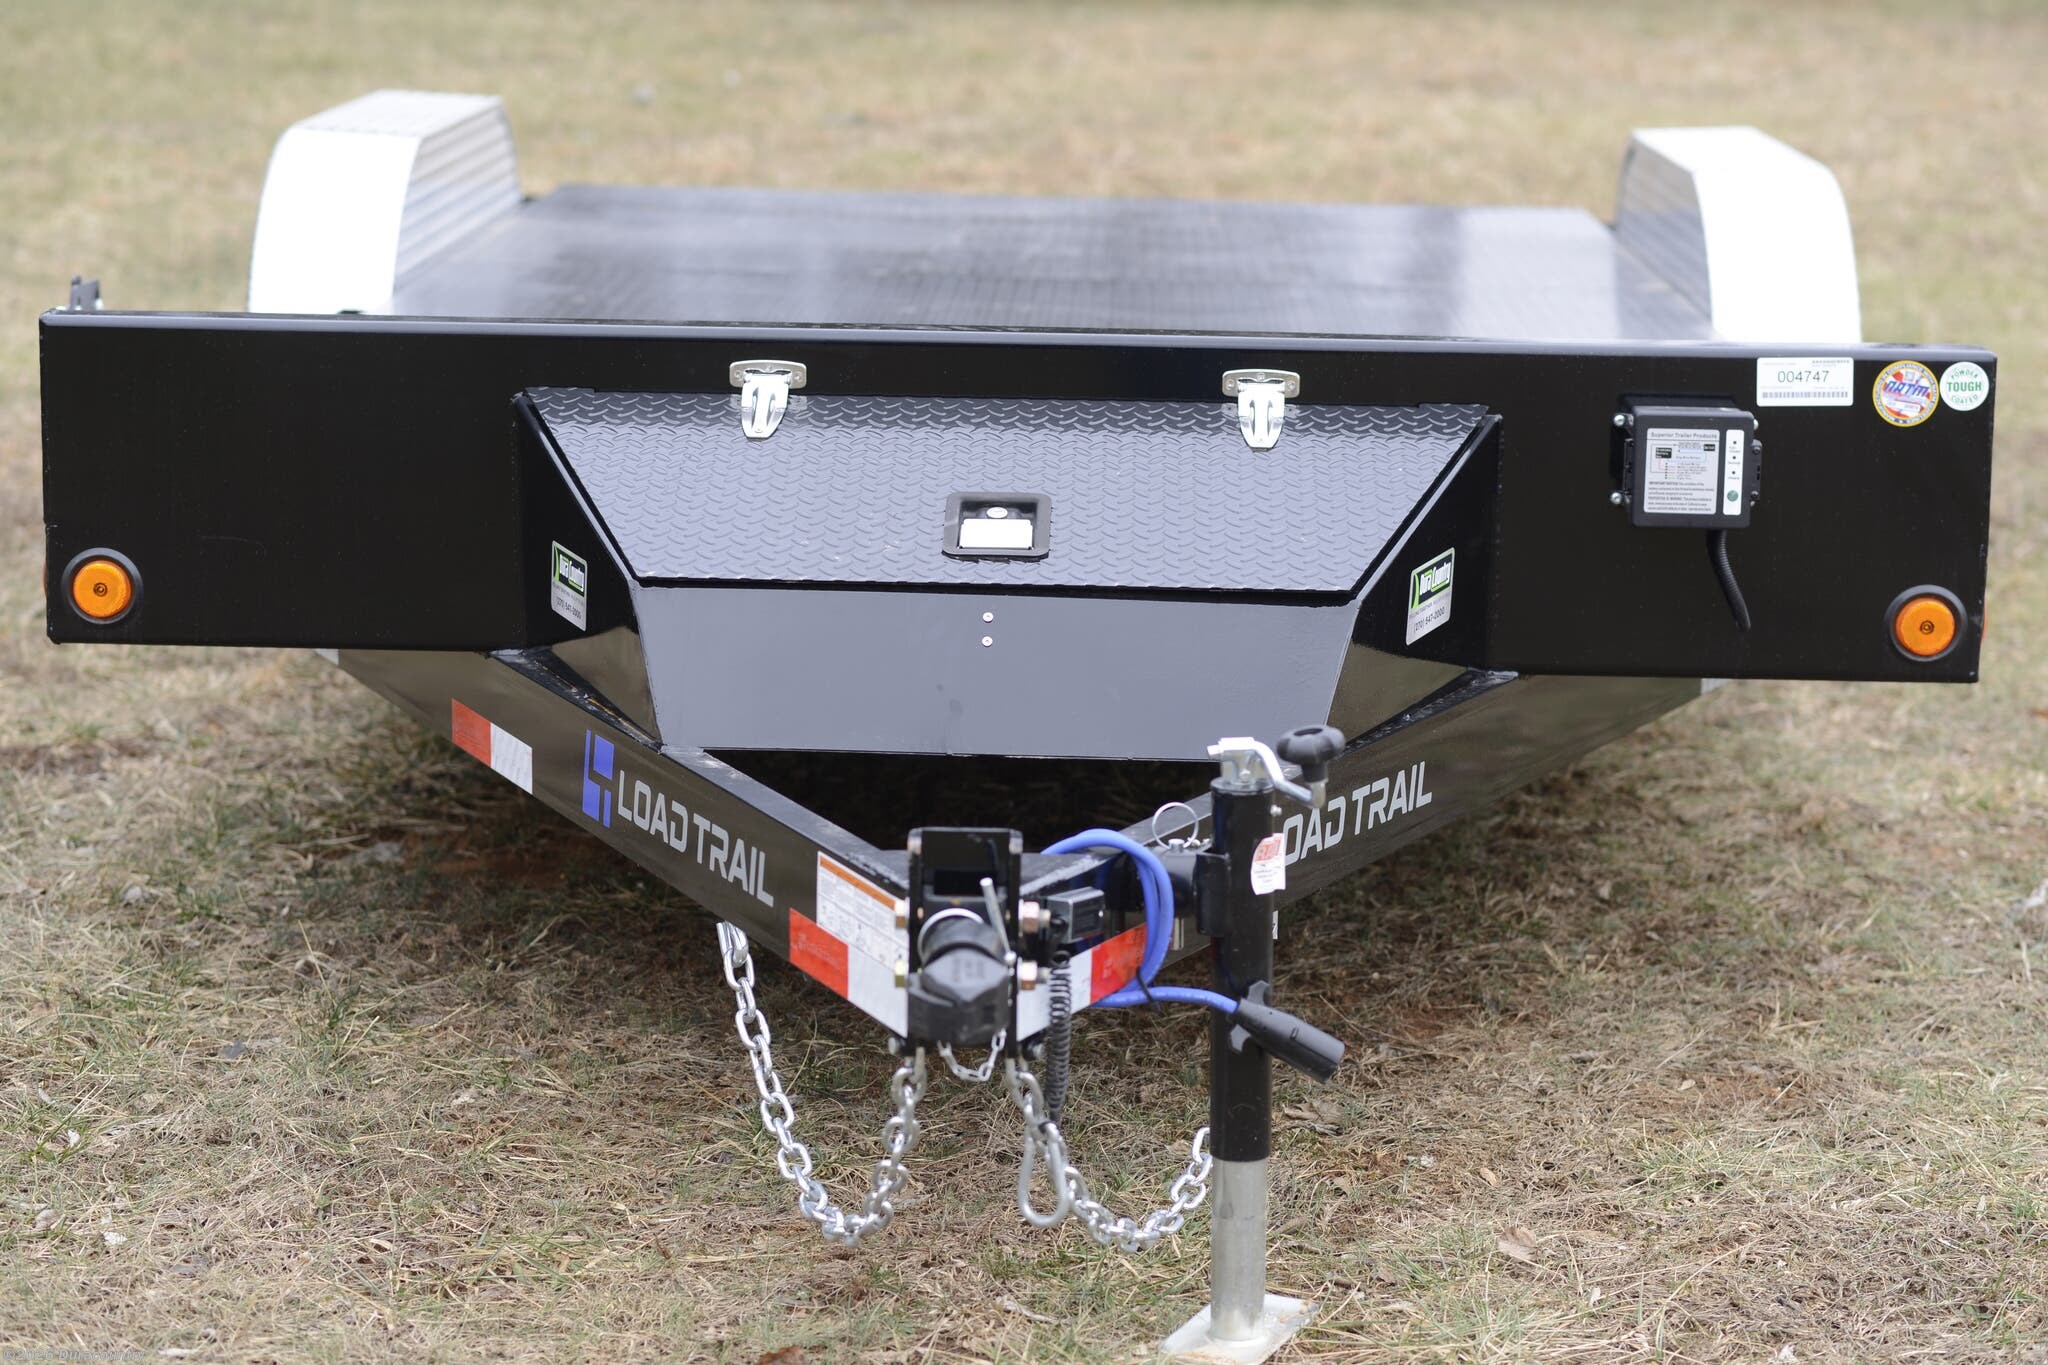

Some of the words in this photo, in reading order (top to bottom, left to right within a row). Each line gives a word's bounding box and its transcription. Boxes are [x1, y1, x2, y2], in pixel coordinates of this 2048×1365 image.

[1777, 370, 1830, 383] 004747
[1951, 369, 1978, 379] POWDER
[1947, 382, 1982, 392] TOUGH
[1951, 394, 1978, 404] COATED
[1283, 796, 1346, 867] OAD
[1352, 761, 1433, 836] TRAIL
[617, 770, 689, 853] LOAD
[693, 812, 774, 908] TRAIL
